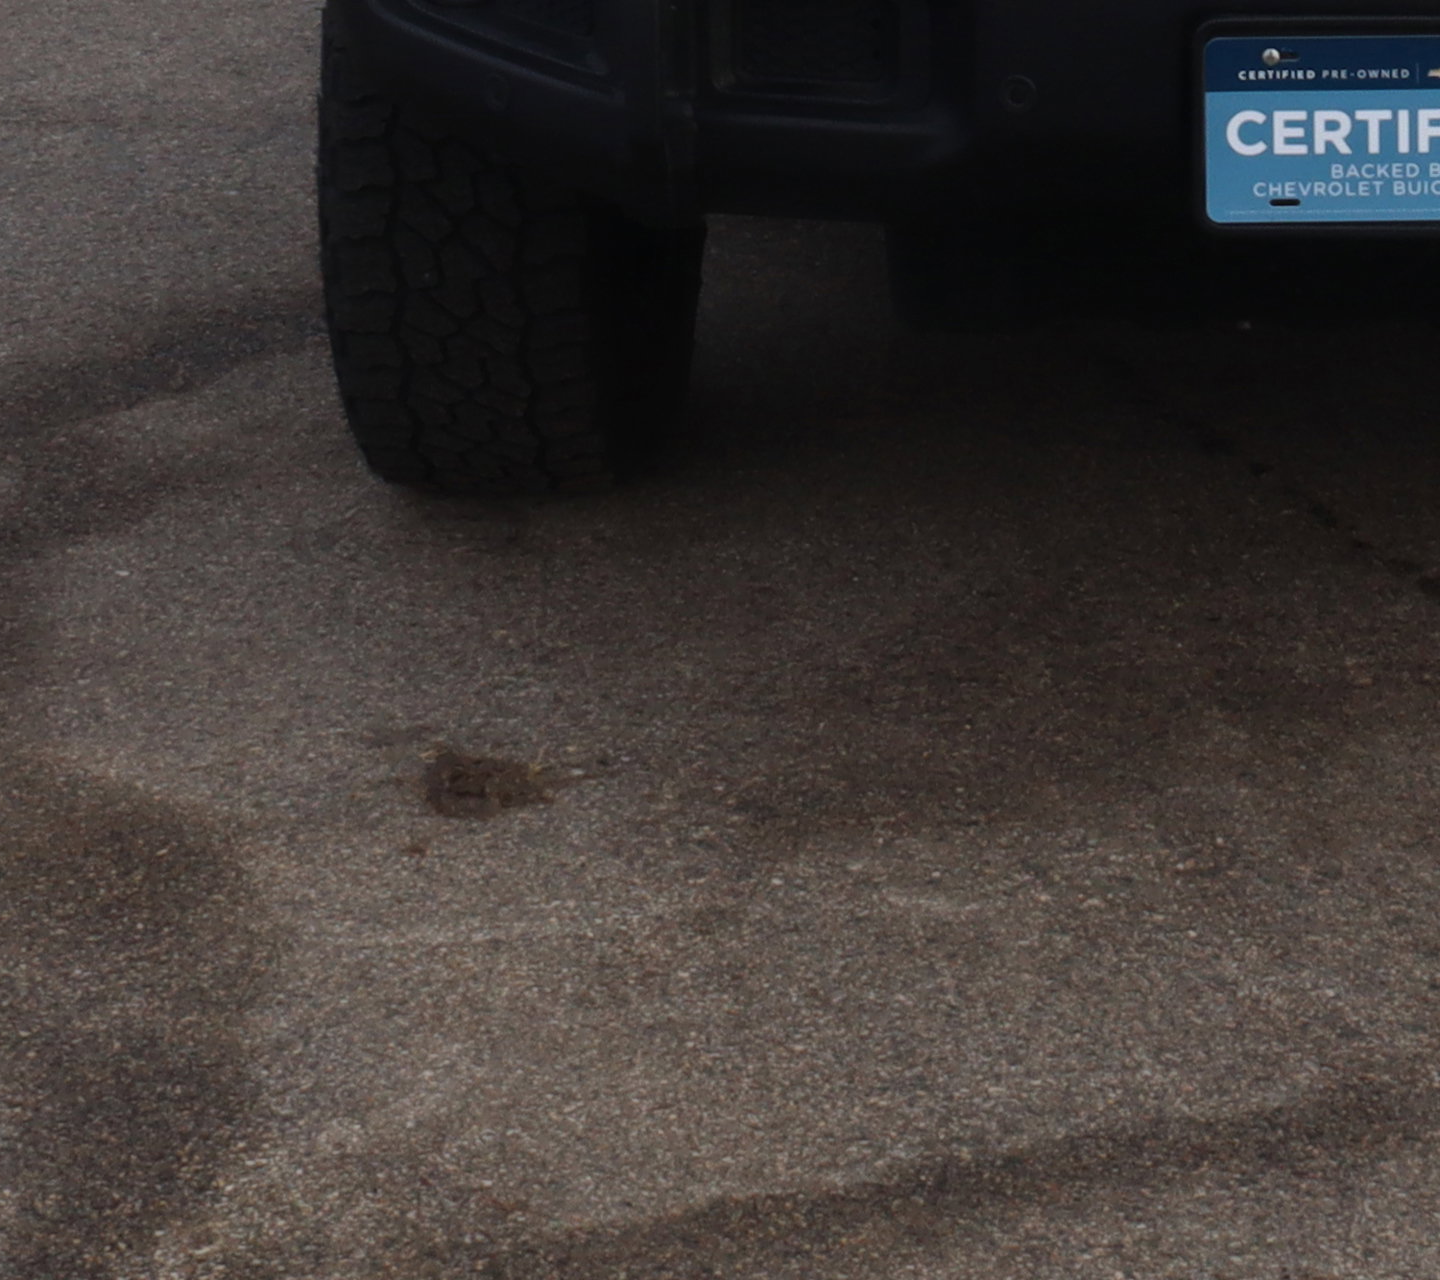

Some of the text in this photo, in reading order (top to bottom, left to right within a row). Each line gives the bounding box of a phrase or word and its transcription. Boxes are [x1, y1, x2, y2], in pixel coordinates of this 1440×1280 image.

[1238, 68, 1410, 81] CERTIFIED PRE-OWNED
[1331, 163, 1420, 179] BACKED
[1252, 181, 1384, 198] CHEVROLET
